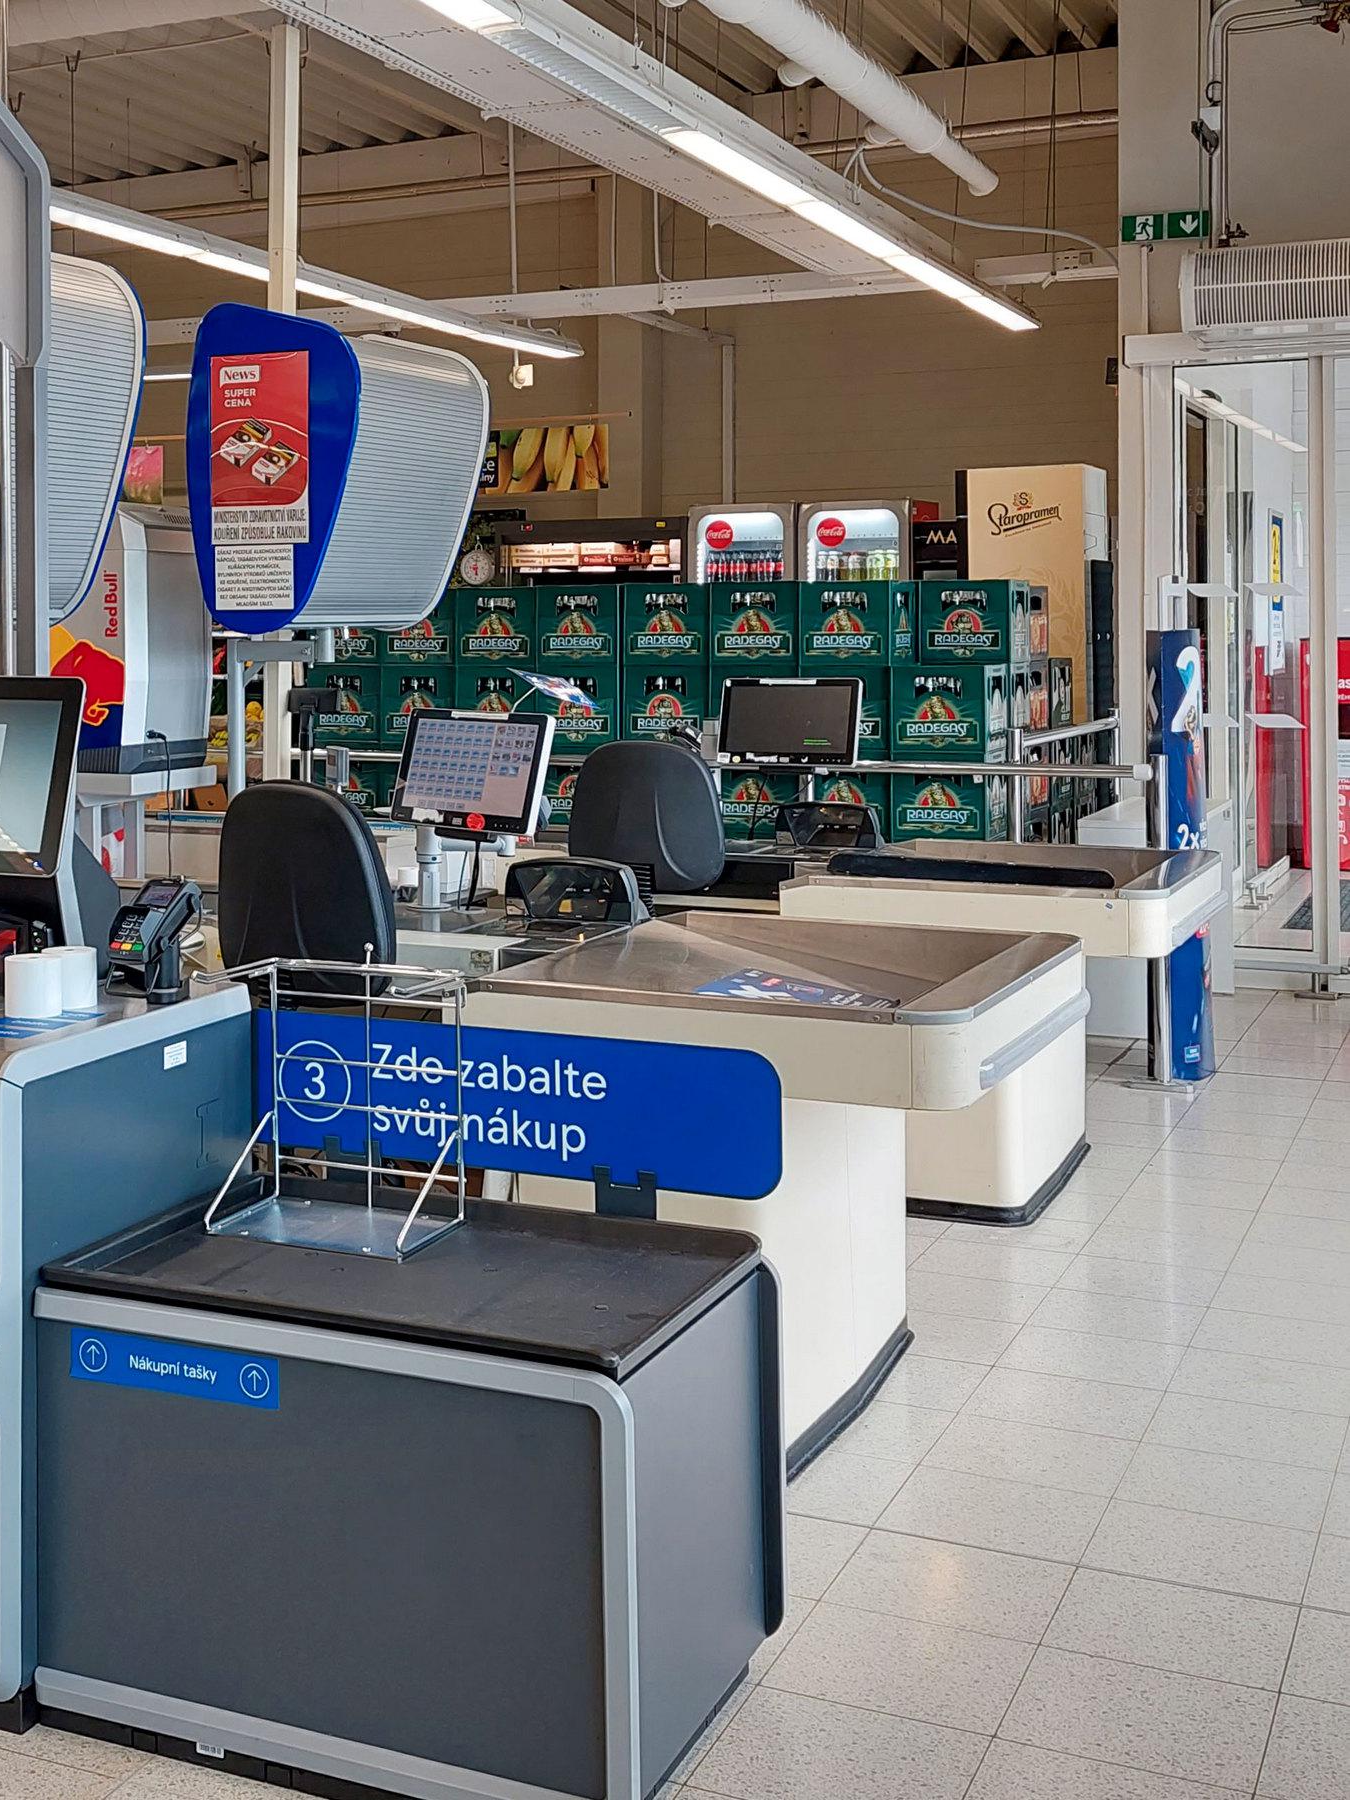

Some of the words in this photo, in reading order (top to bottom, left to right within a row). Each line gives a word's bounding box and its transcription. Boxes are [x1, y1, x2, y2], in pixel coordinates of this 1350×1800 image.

[224, 370, 256, 381] News
[224, 388, 256, 397] SUPER
[224, 399, 251, 407] CENA
[988, 503, 1062, 536] Staropramen
[214, 525, 240, 540] KOUŘENÍ
[276, 525, 307, 539] RAKOVINU
[818, 526, 844, 539] Coca-Cola
[104, 572, 118, 605] Bull
[105, 606, 118, 638] Red
[394, 639, 444, 652] RADEGAST
[469, 637, 522, 651] RADEGAST
[550, 637, 604, 650] RADEGAST
[638, 635, 694, 649] RADEGAST
[724, 635, 783, 648] RADEGAST
[813, 635, 874, 648] RADEGAST
[934, 634, 995, 646] RADEGAST
[319, 714, 369, 727] RADEGAST
[554, 719, 604, 731] ADEGAST
[907, 723, 970, 737] RADEGAST
[907, 809, 970, 823] RADEGAST
[371, 1043, 444, 1085] Zde
[460, 1053, 608, 1100] zabalte
[303, 1061, 327, 1100] 3
[372, 1098, 449, 1148] svůj
[462, 1106, 587, 1161] nákup
[129, 1354, 180, 1377] Nákupní
[182, 1365, 217, 1385] tašky
